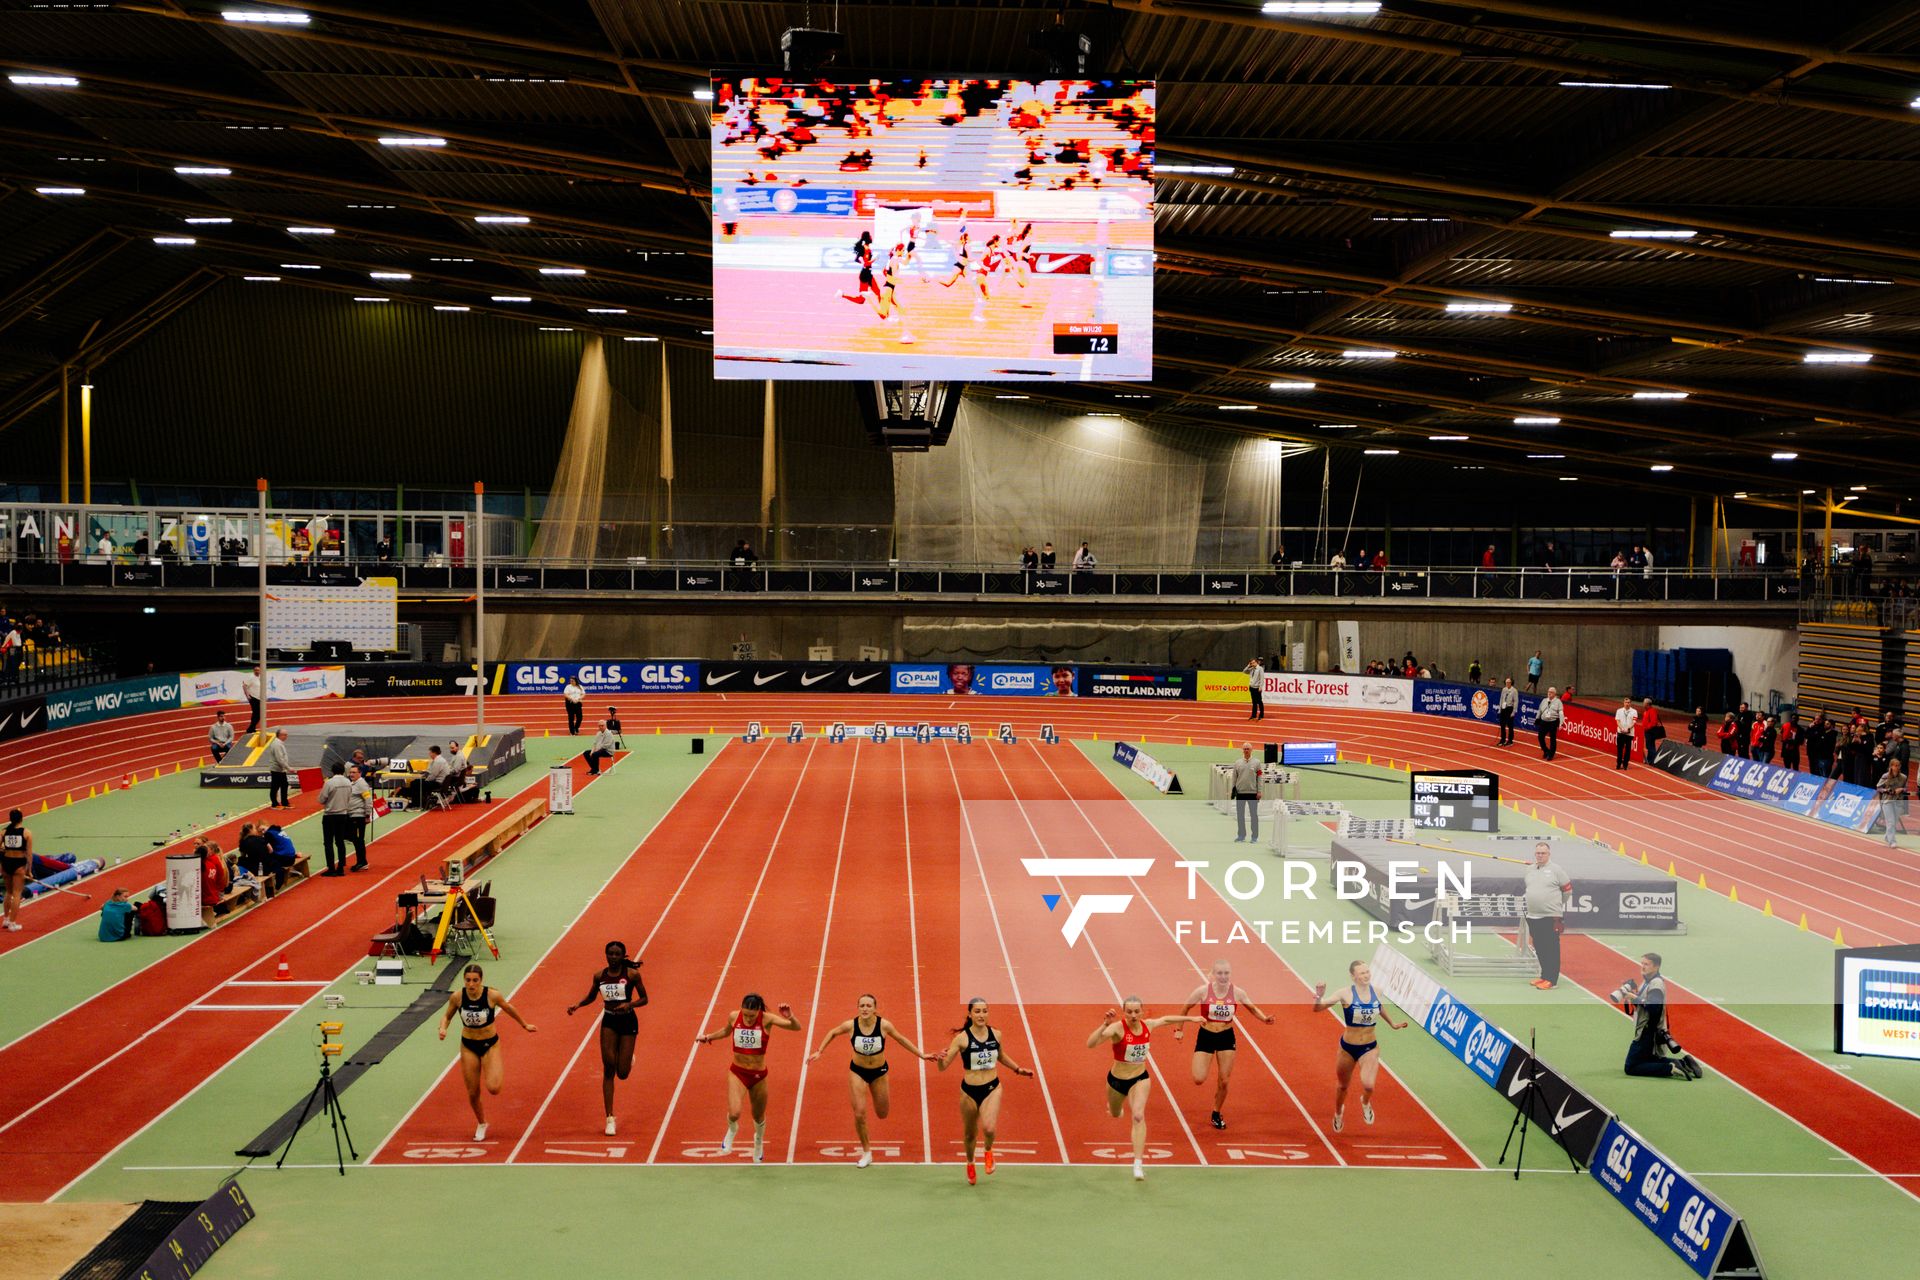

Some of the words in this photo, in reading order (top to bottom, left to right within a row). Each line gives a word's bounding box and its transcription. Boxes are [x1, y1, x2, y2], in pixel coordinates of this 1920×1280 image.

[1090, 338, 1109, 352] 7.2
[298, 653, 304, 661] 2
[330, 646, 338, 657] 1
[364, 653, 371, 661] 3
[395, 679, 443, 687] TRUEATHLETES
[914, 674, 938, 682] PLAN
[1010, 675, 1033, 684] PLAN
[1093, 685, 1182, 697] SPORTLAND.NRW
[1264, 678, 1303, 694] Black
[1307, 679, 1349, 696] Forest
[148, 684, 179, 703] WGV
[1421, 694, 1434, 703] Das
[1435, 694, 1453, 703] Event
[1453, 694, 1462, 703] für
[95, 691, 123, 712] WGV
[47, 700, 73, 721] WGV
[1443, 703, 1467, 712] Familie
[750, 724, 759, 736] 8
[792, 725, 801, 736] 7
[834, 725, 843, 736] 6
[876, 725, 885, 736] 5
[918, 726, 928, 737] 4
[960, 726, 968, 737] 3
[1001, 727, 1010, 738] 2
[1044, 727, 1051, 738] 1
[1562, 717, 1602, 739] Sparkasse
[1415, 783, 1474, 795] GRETZLER
[1415, 794, 1439, 804] Lotte
[1415, 804, 1431, 815] RL
[1423, 816, 1447, 827] 4.10
[1562, 894, 1600, 913] LS.
[1643, 896, 1673, 905] PLAN
[1445, 1005, 1468, 1036] PLAN
[1883, 1029, 1910, 1039] WEST
[739, 1036, 756, 1044] 330
[863, 1043, 874, 1051] 87
[1480, 1032, 1507, 1067] PLAN
[403, 1147, 488, 1159] 8
[544, 1146, 628, 1158] 7
[1226, 1149, 1311, 1160] 2
[229, 1186, 245, 1207] 12
[198, 1212, 214, 1233] 13
[169, 1239, 184, 1261] 14
